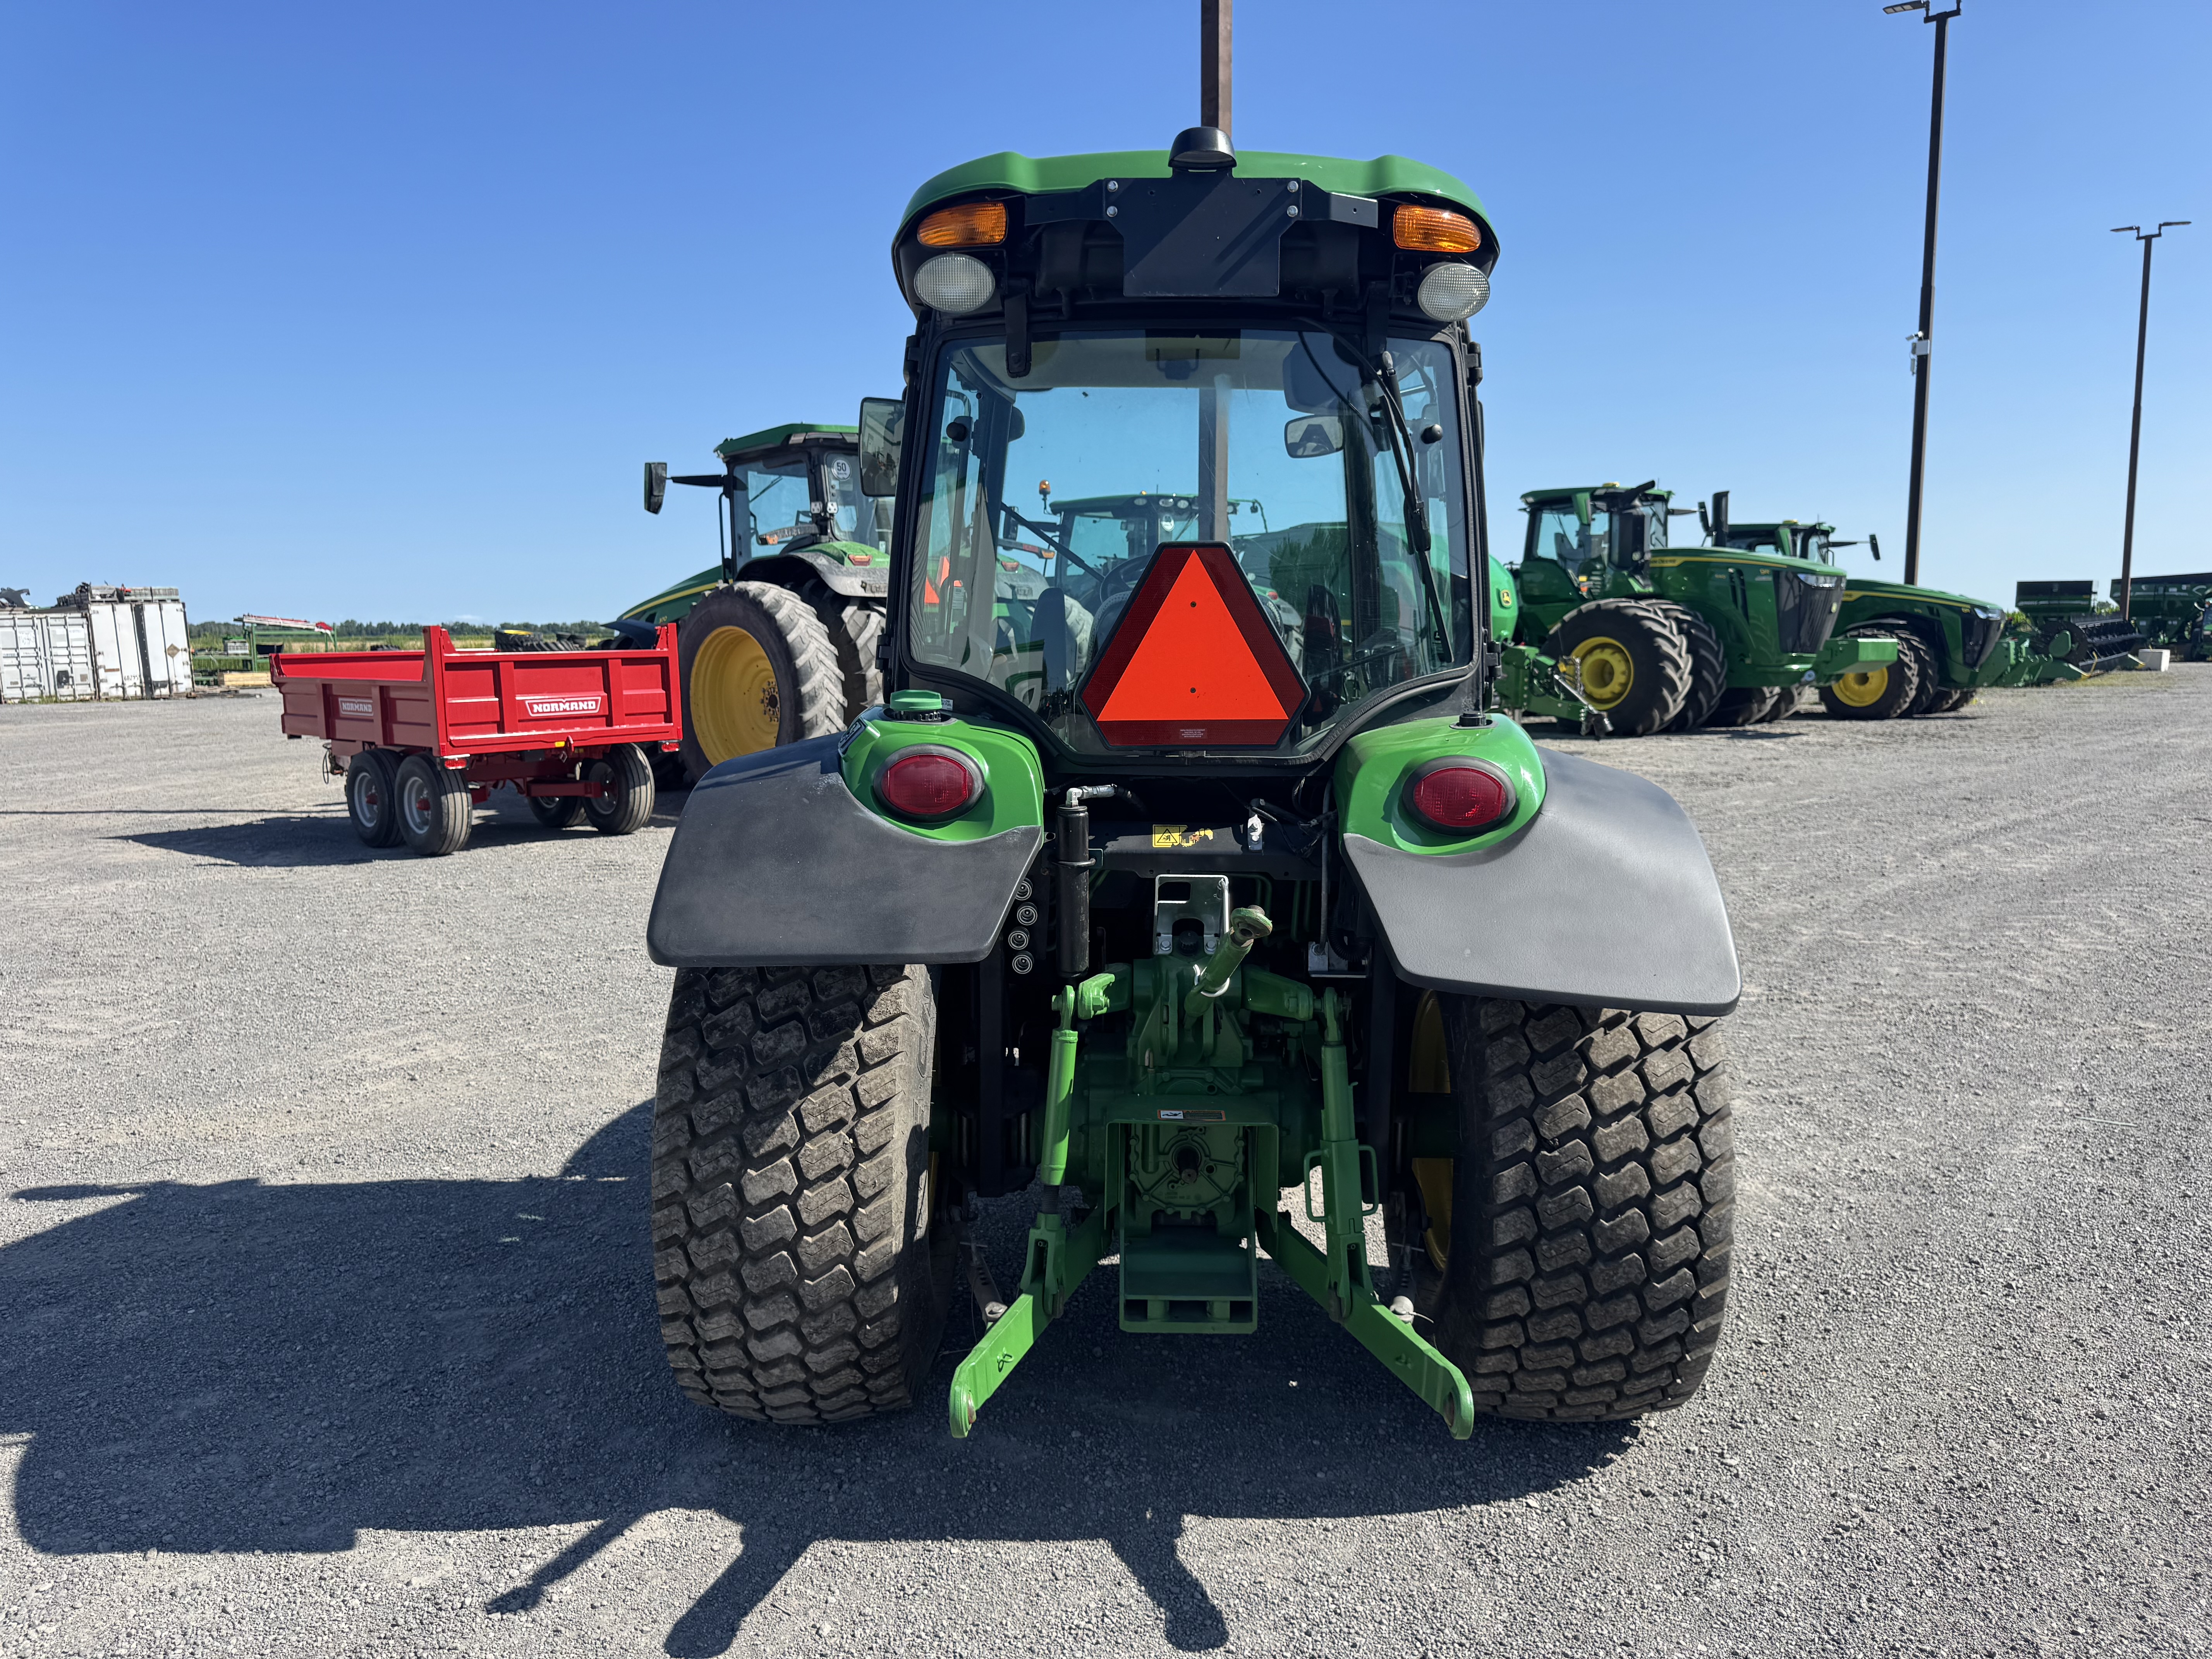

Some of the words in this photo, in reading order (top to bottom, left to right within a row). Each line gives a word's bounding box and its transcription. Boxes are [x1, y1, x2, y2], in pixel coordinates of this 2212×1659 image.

[837, 462, 846, 471] 50
[342, 702, 372, 712] NORMAND
[533, 701, 596, 713] NORMAND
